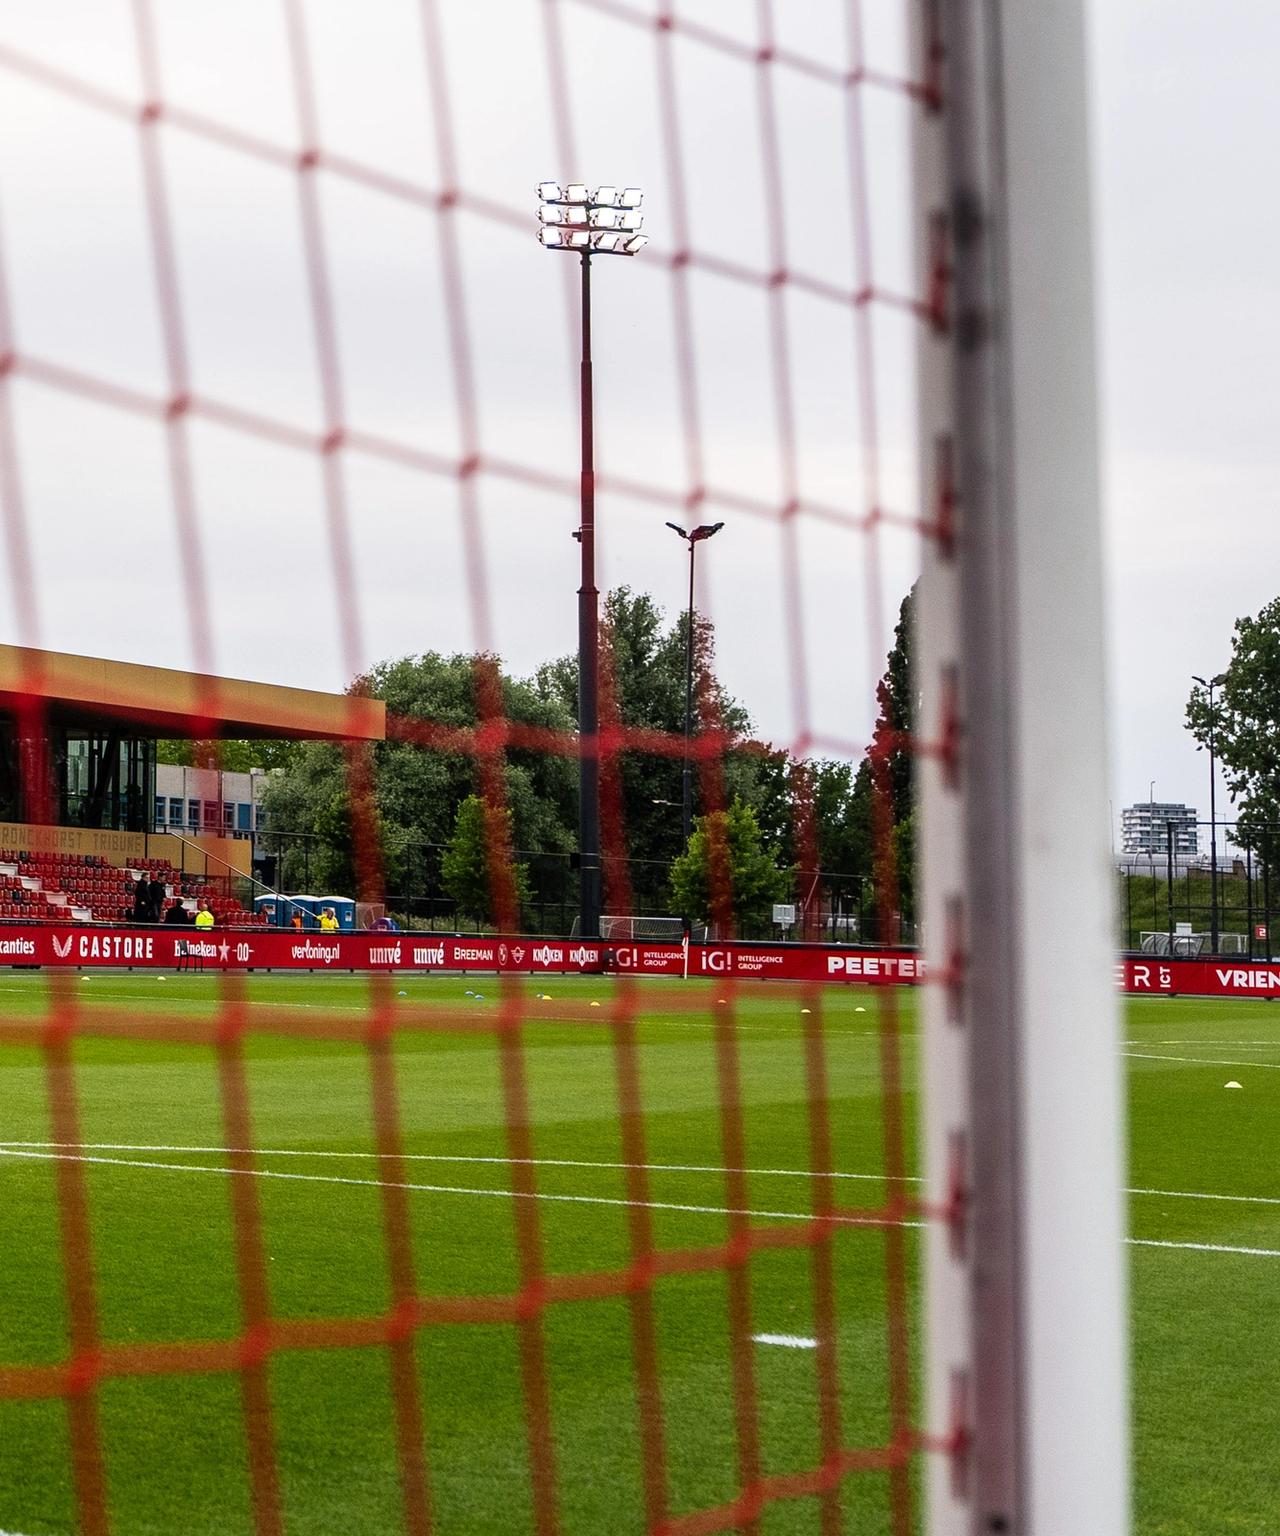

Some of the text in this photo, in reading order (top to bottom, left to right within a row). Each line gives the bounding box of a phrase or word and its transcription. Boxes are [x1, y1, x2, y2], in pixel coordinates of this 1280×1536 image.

[93, 833, 143, 852] TRIBUNE
[1258, 927, 1267, 937] 2
[79, 935, 154, 959] CASTORE
[291, 938, 340, 964] verloning.nl
[369, 941, 401, 964] univé
[413, 942, 445, 965] univé
[532, 947, 563, 964] KNAKEN
[643, 951, 685, 960] INTELLIGENC
[570, 948, 599, 965] KNAKEN
[738, 955, 783, 964] INTELLIGENCE
[738, 962, 763, 970] GROUP
[1159, 966, 1171, 988] ICT
